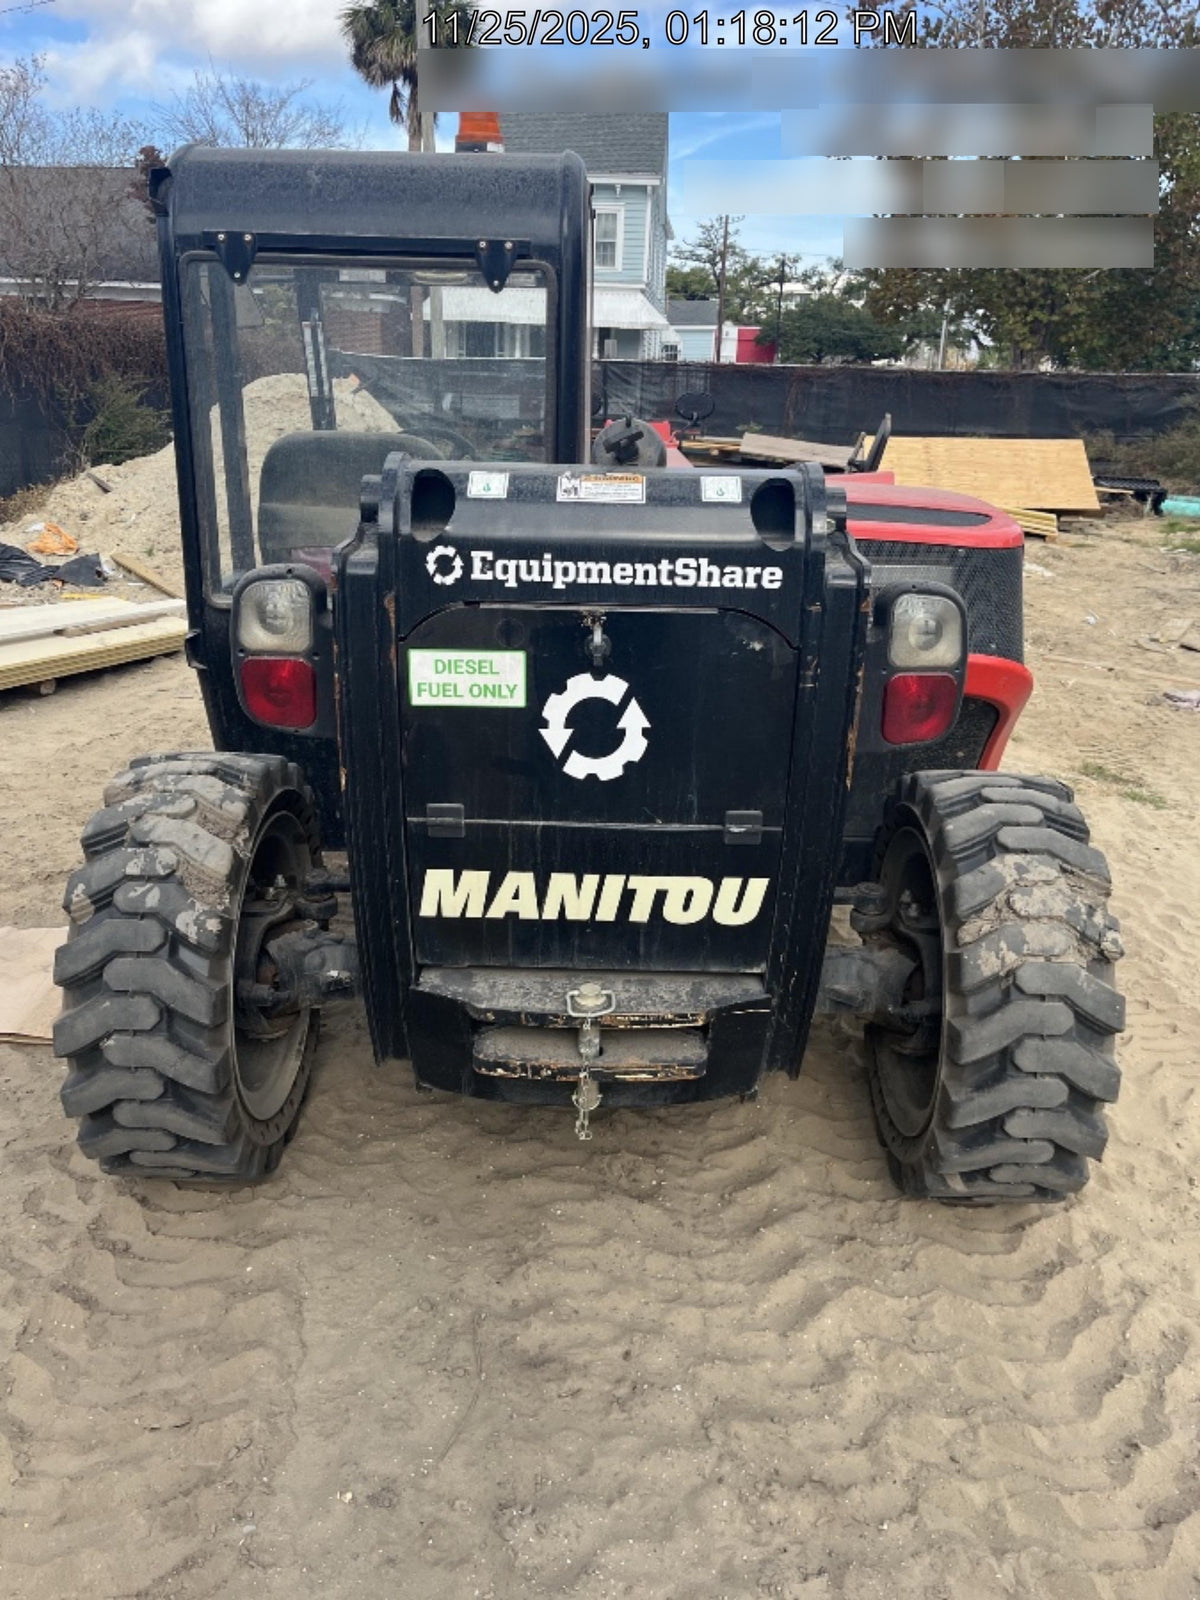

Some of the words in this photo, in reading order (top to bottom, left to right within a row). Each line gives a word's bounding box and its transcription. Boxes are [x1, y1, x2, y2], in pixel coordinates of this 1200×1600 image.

[470, 550, 783, 590] EquipmentShare
[434, 659, 500, 675] DIESEL
[417, 682, 464, 698] FUEL
[469, 683, 518, 699] ONLY
[419, 868, 771, 926] MANITOU
